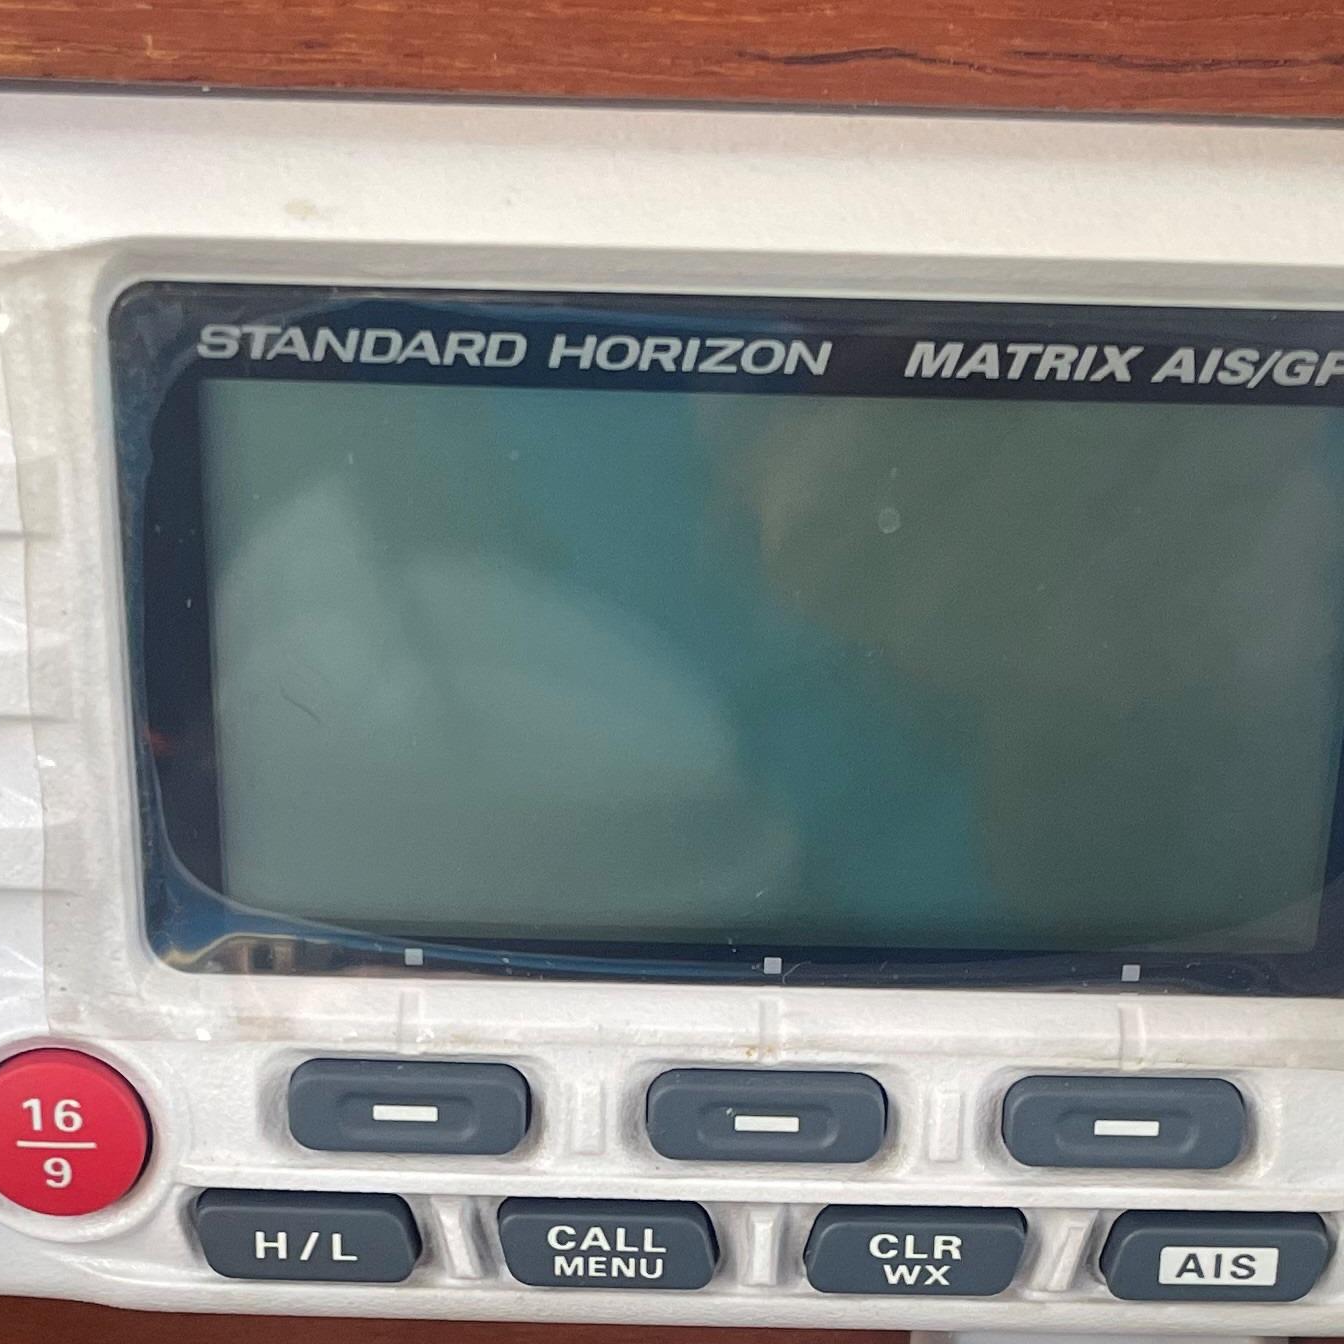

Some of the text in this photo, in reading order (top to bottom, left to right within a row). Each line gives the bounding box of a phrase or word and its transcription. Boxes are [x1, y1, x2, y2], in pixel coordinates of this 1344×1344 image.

[196, 323, 833, 375] STANDARD HORIZON
[904, 341, 1144, 383] MATRIX
[22, 1097, 84, 1132] 16
[42, 1157, 73, 1190] 9
[547, 1225, 667, 1254] CALL
[868, 1233, 962, 1262] CLR
[553, 1256, 664, 1279] MENU
[883, 1264, 951, 1287] WX
[1174, 1253, 1257, 1280] AIS
